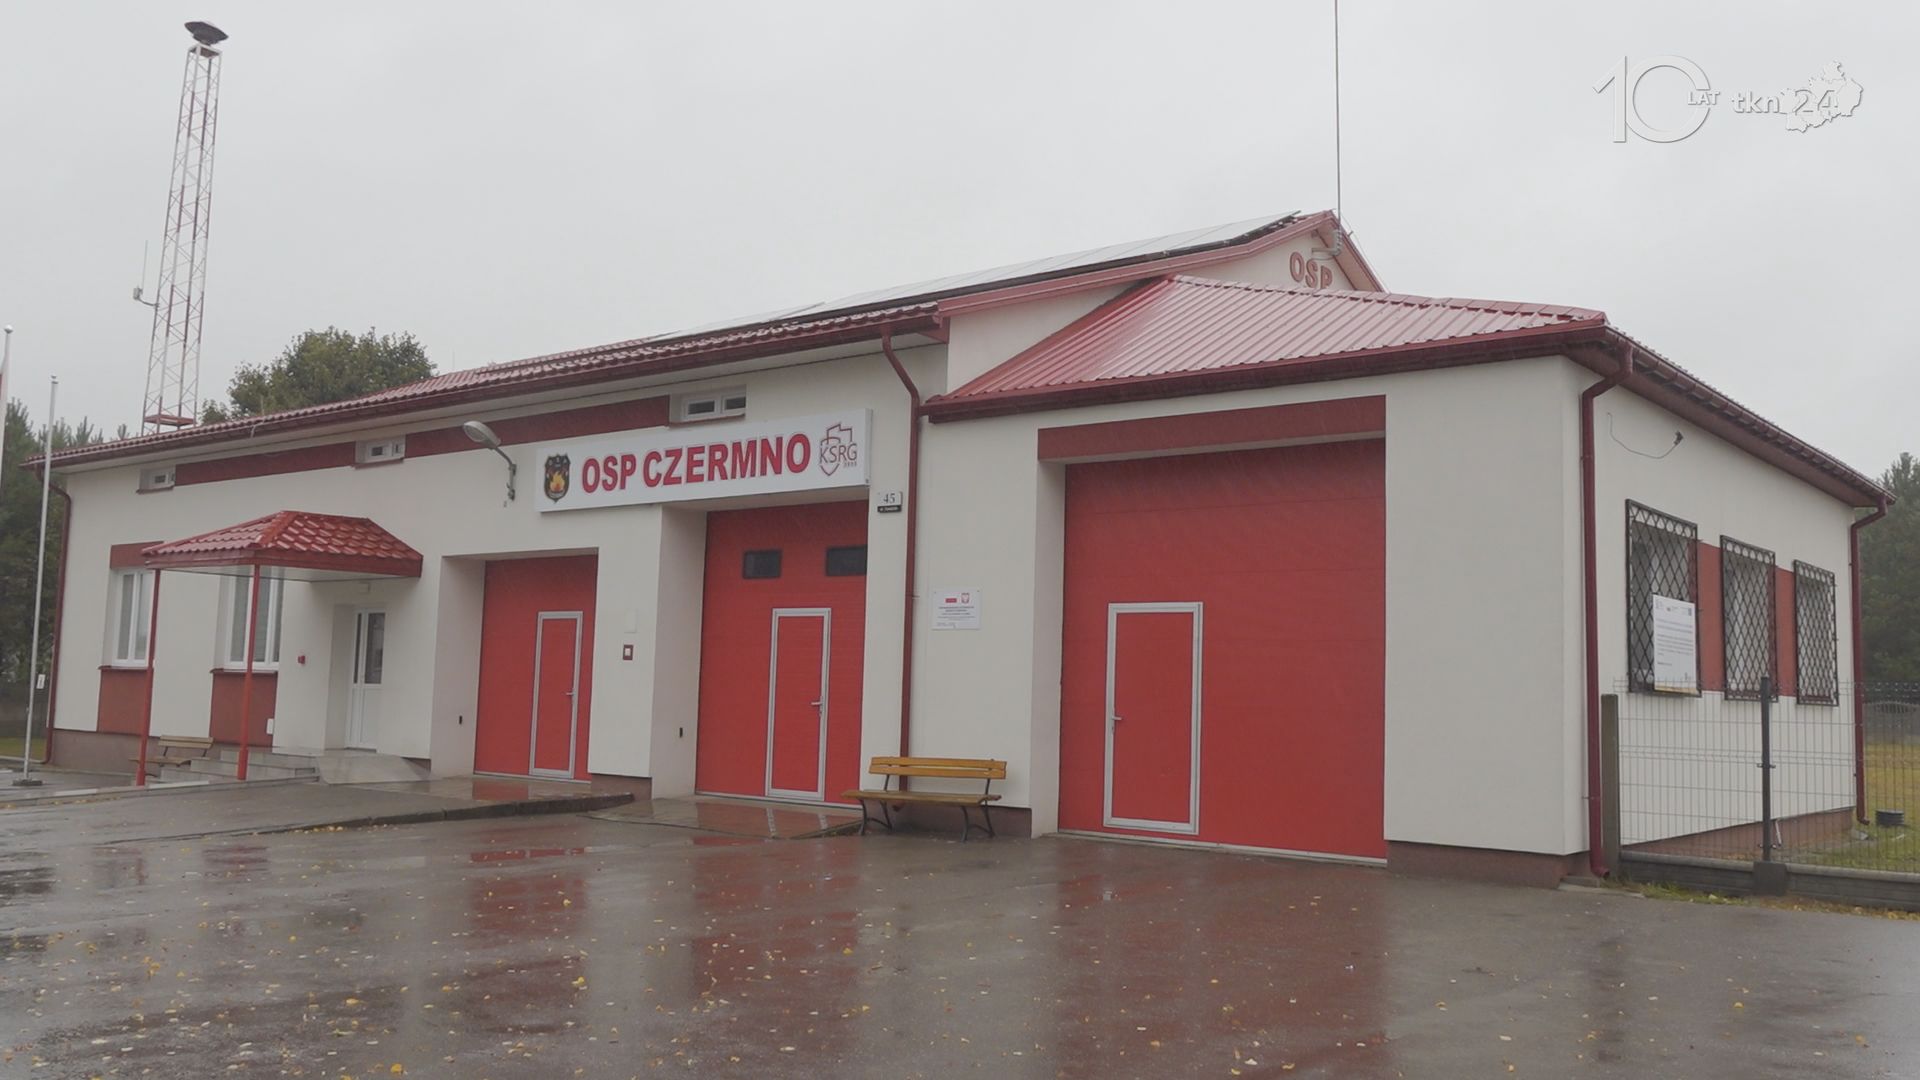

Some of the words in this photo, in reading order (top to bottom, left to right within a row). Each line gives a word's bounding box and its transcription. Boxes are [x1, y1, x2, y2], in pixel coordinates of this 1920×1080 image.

[1289, 251, 1333, 289] OSP
[581, 454, 637, 494] OSP
[643, 433, 811, 488] CZERMNO
[820, 443, 858, 464] KSRG
[883, 493, 896, 503] 45
